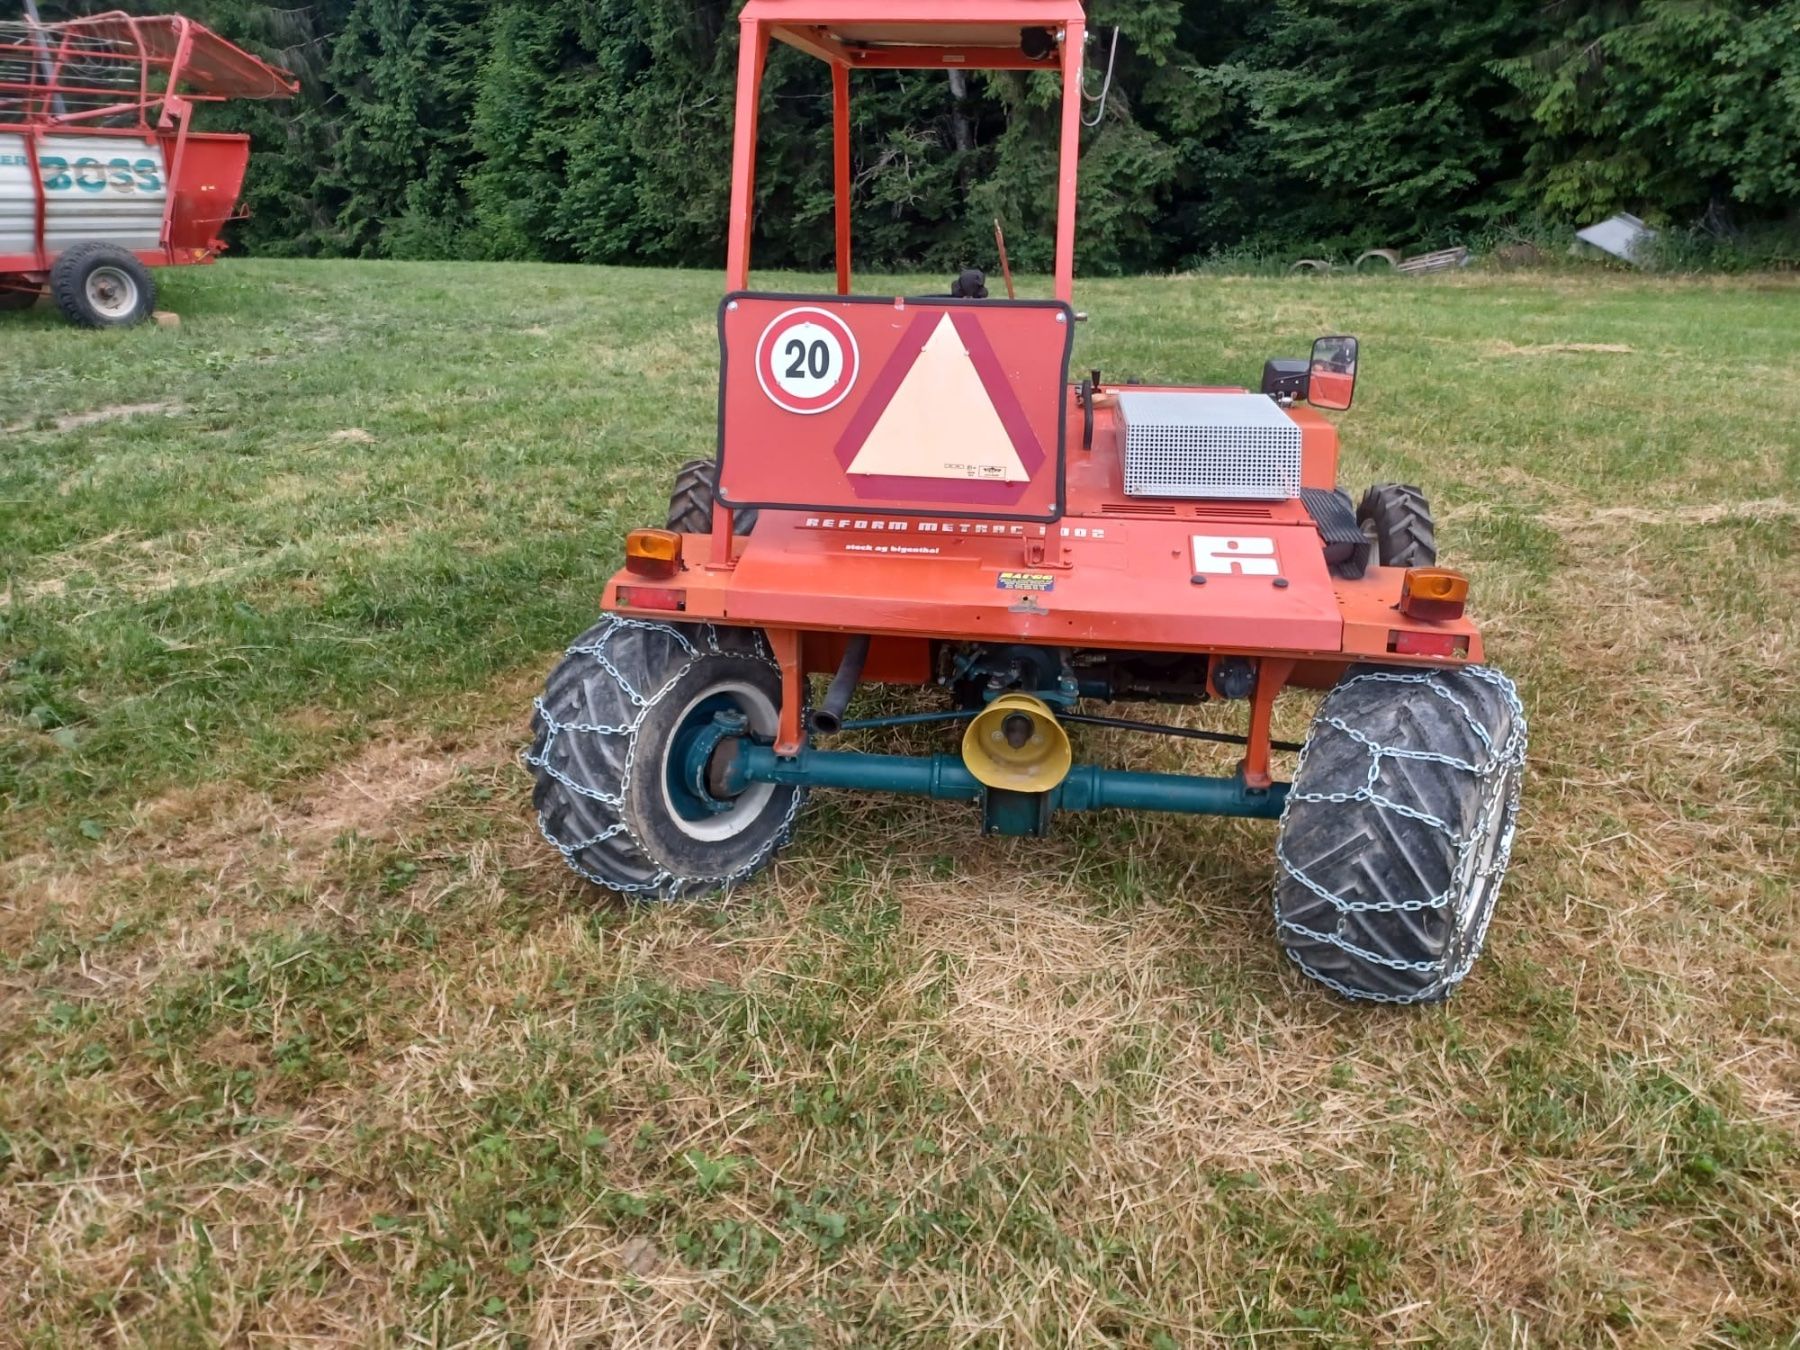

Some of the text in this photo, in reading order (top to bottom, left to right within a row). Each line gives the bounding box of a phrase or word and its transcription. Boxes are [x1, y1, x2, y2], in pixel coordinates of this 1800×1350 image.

[39, 156, 161, 193] BOSS
[785, 339, 830, 379] 20
[805, 518, 908, 531] REFORM
[918, 522, 1024, 535] METRAC
